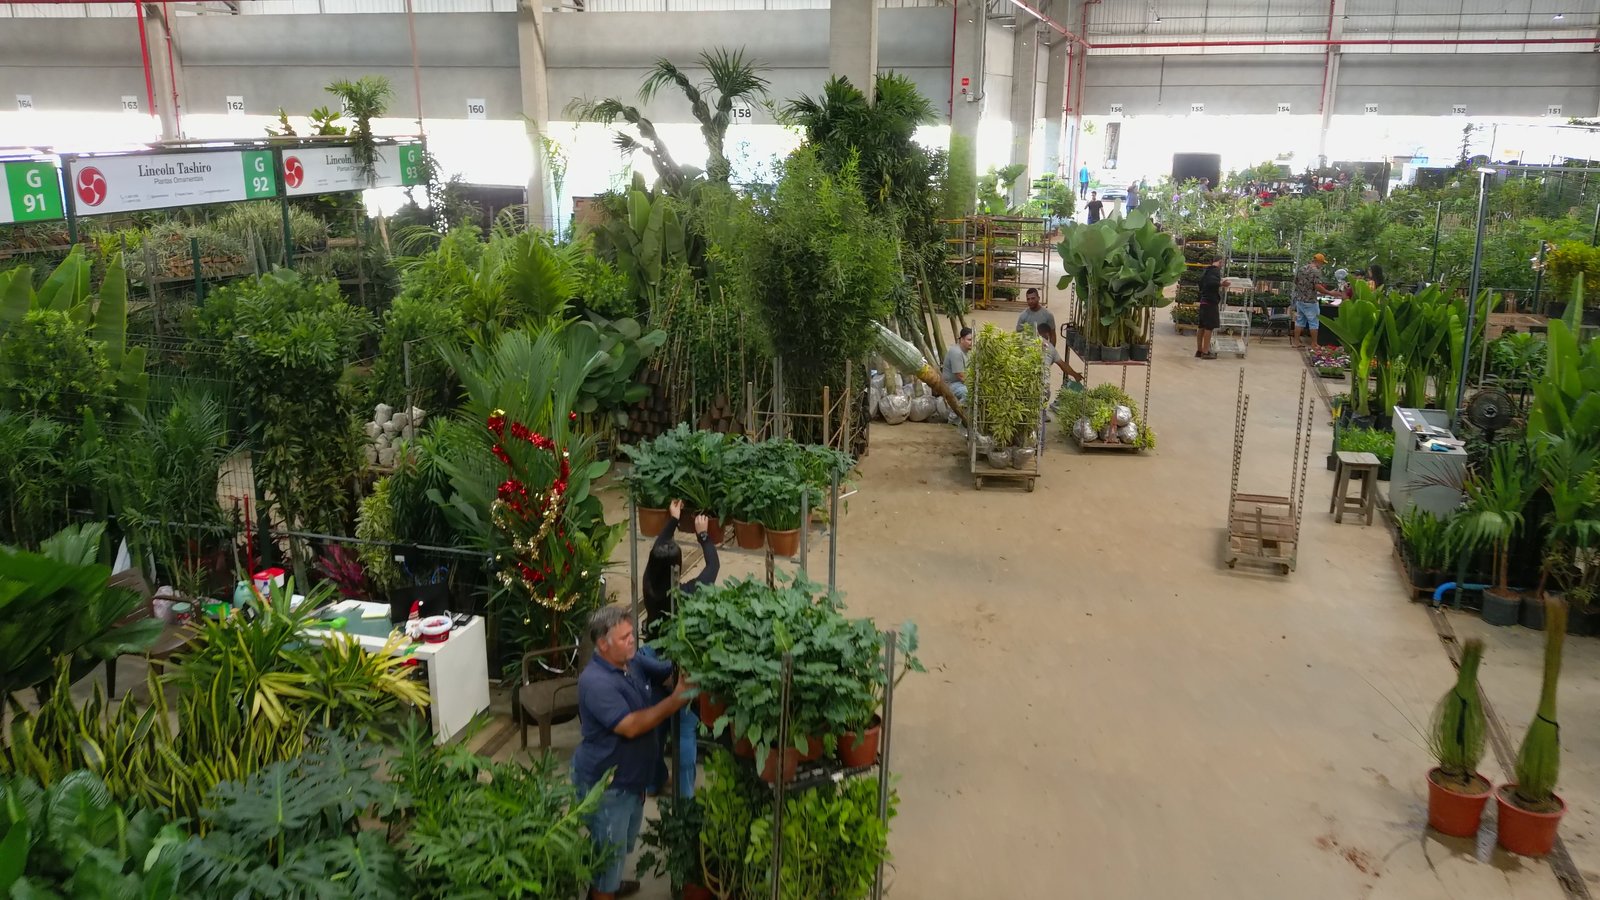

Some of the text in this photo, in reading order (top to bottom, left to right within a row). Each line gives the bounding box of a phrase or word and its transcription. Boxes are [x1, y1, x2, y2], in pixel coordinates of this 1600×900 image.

[121, 101, 138, 110] 163
[227, 101, 244, 111] 162
[468, 104, 485, 114] 160
[732, 108, 752, 118] 158
[326, 153, 352, 166] Lincoln
[408, 150, 415, 162] G
[138, 161, 212, 177] Lincoln Tashiro
[254, 157, 265, 173] G
[26, 169, 42, 188] G
[406, 166, 418, 180] 93
[252, 176, 270, 193] 92
[23, 193, 46, 213] 91
